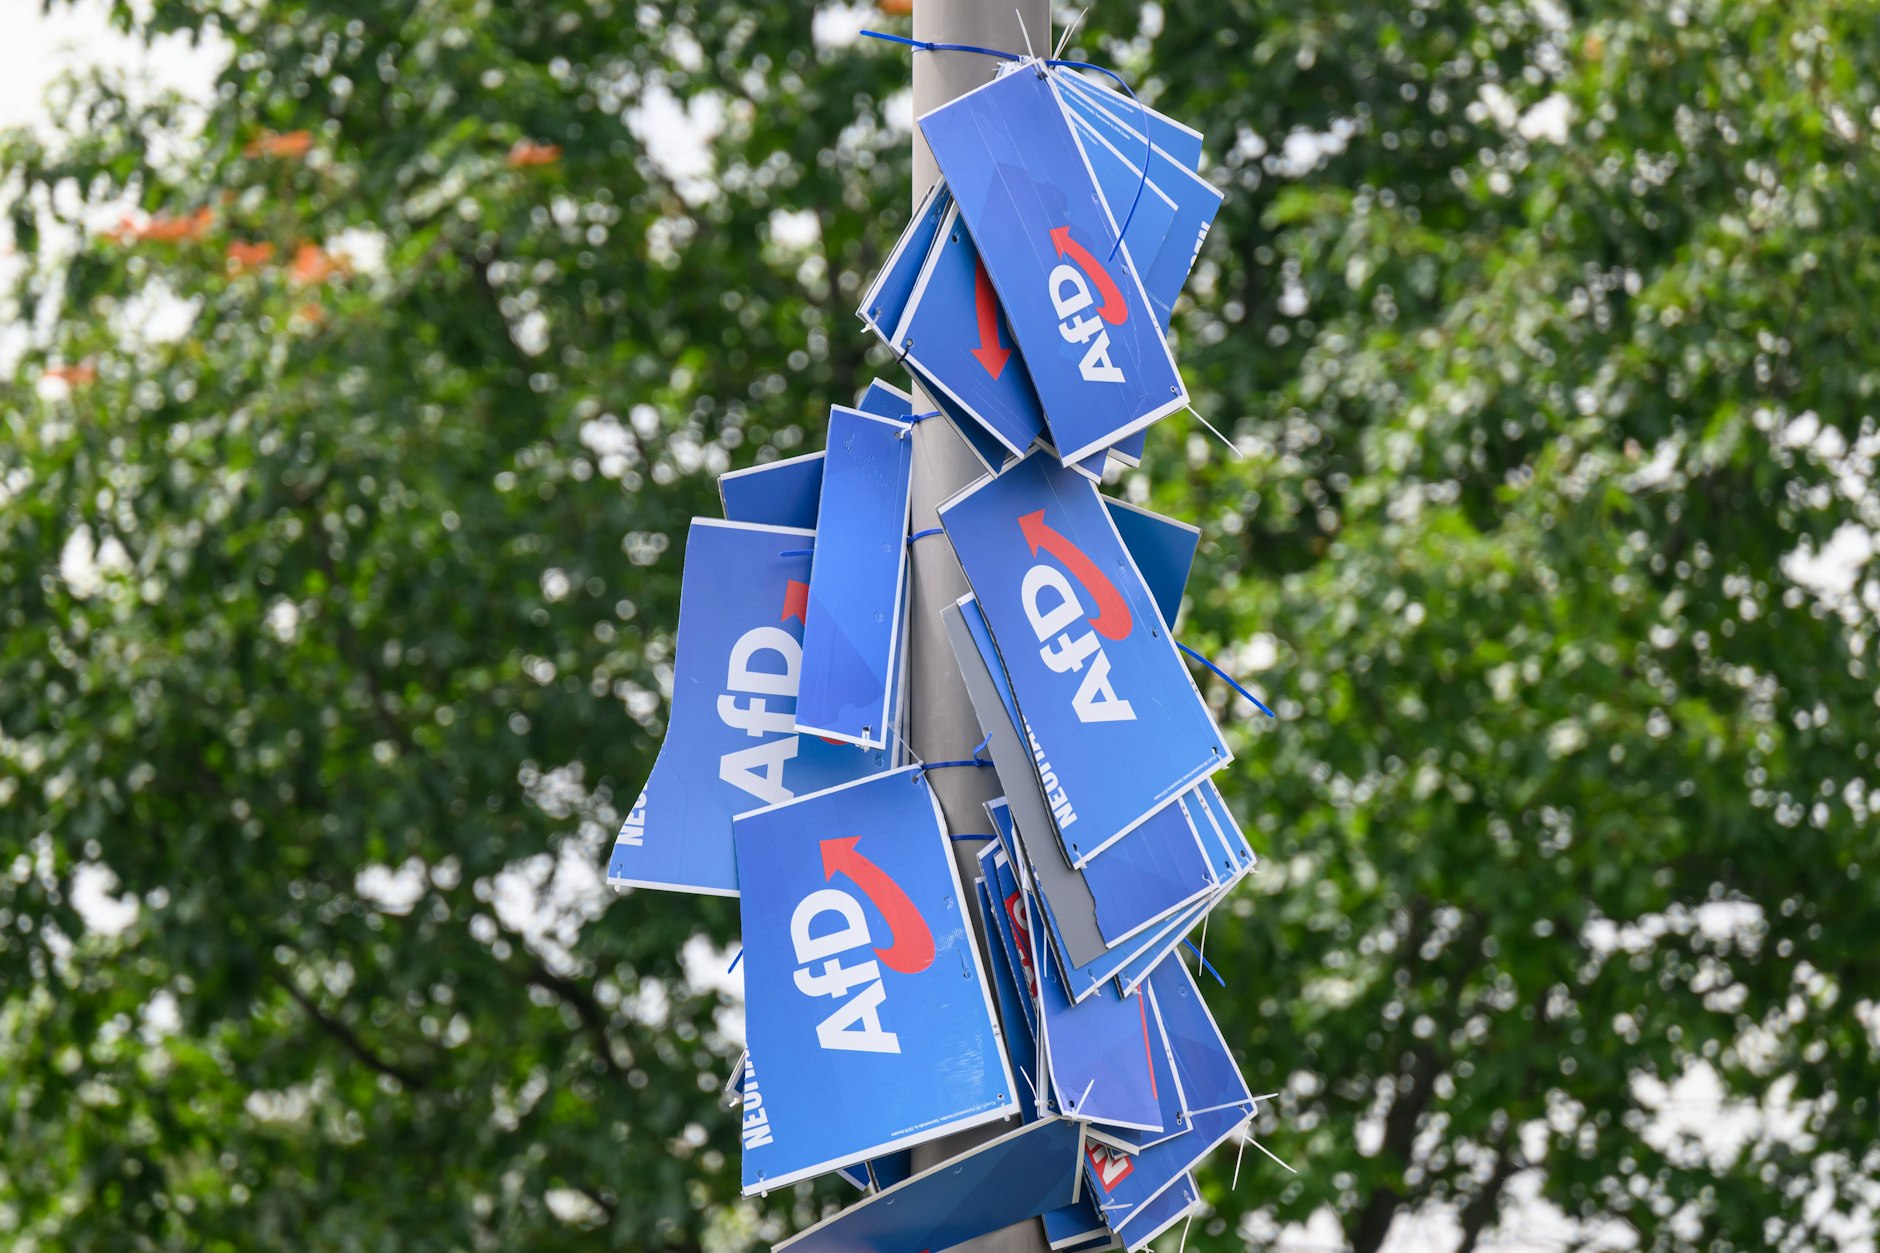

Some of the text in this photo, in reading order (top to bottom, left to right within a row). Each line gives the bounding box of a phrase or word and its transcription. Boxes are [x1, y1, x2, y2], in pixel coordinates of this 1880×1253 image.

[1048, 264, 1125, 383] AfD
[716, 626, 803, 805] AfD
[1021, 564, 1136, 723] AfD
[790, 889, 901, 1054] AfD
